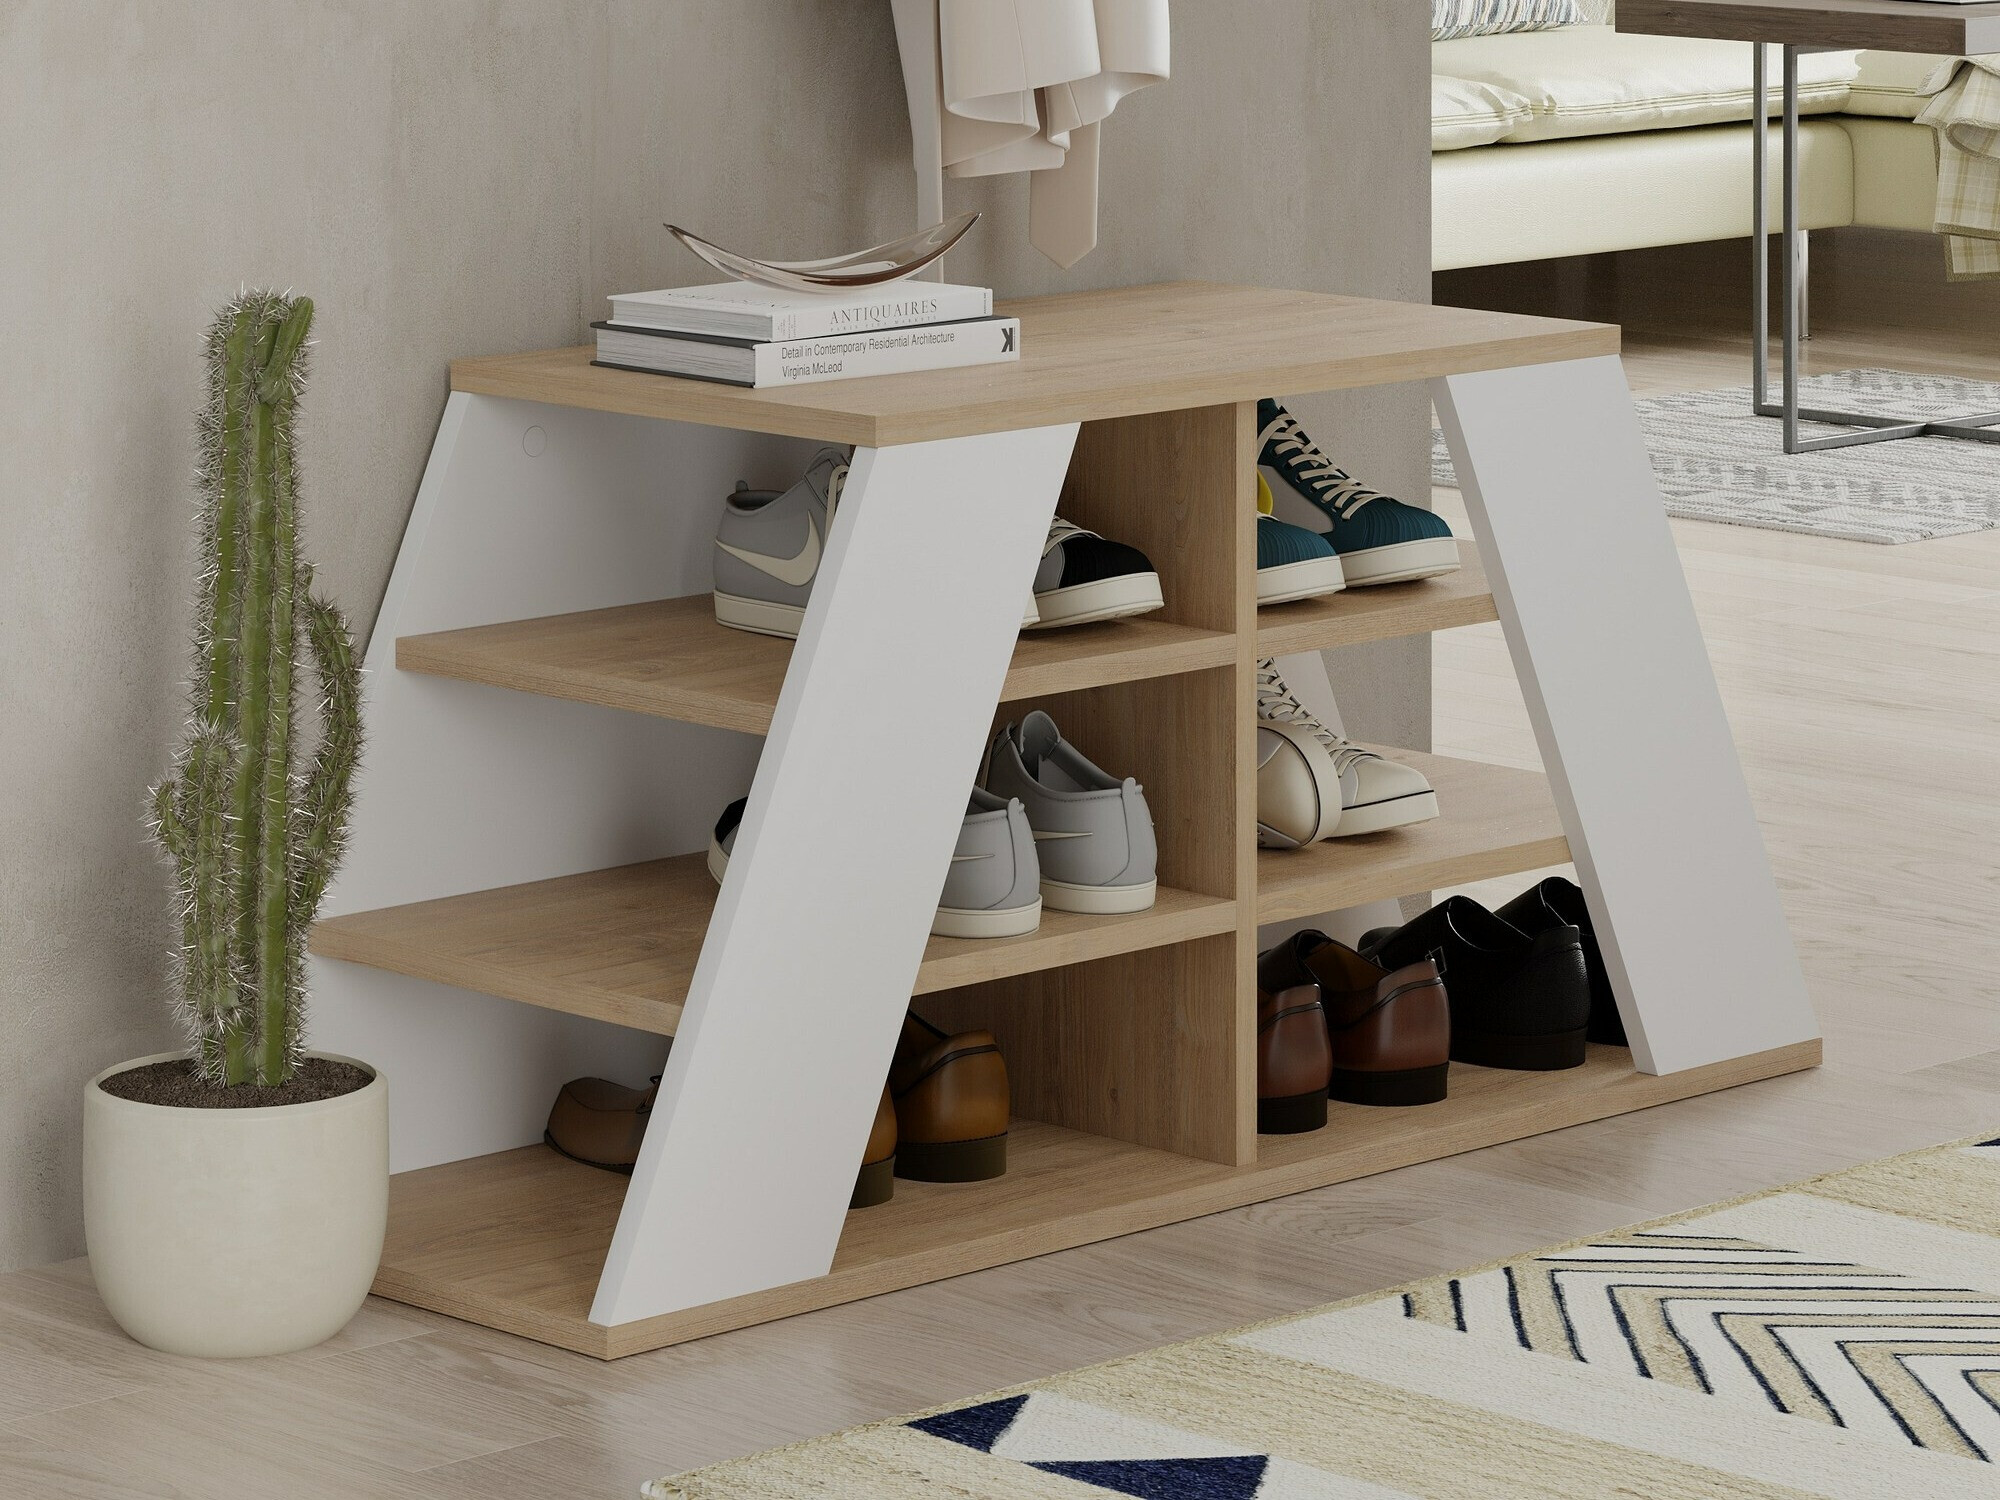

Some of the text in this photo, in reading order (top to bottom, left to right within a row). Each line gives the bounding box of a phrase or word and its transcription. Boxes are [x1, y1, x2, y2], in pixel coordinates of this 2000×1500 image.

[831, 299, 937, 324] ANTIQUAIRES
[782, 333, 955, 360] Detail in Contemporary Residential Architecture
[782, 361, 843, 380] Virginia McLeod
